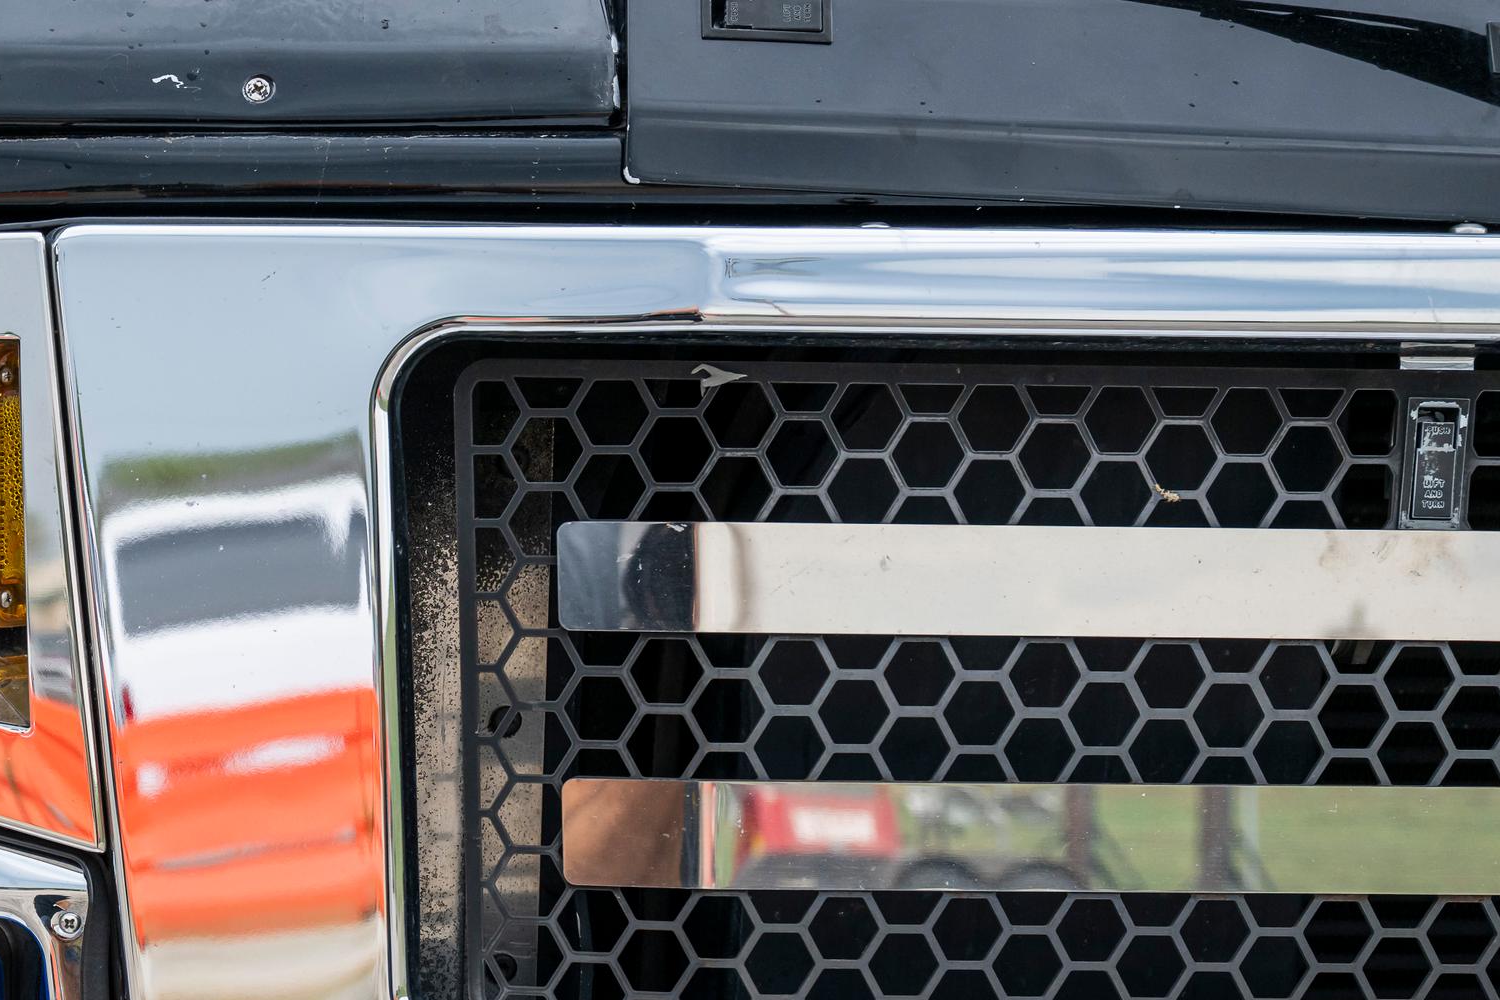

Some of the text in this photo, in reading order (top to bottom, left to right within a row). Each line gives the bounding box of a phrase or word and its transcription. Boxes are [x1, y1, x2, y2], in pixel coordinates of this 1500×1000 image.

[1423, 478, 1446, 489] LIFT
[1424, 489, 1444, 499] AND
[1421, 500, 1445, 510] TURN
